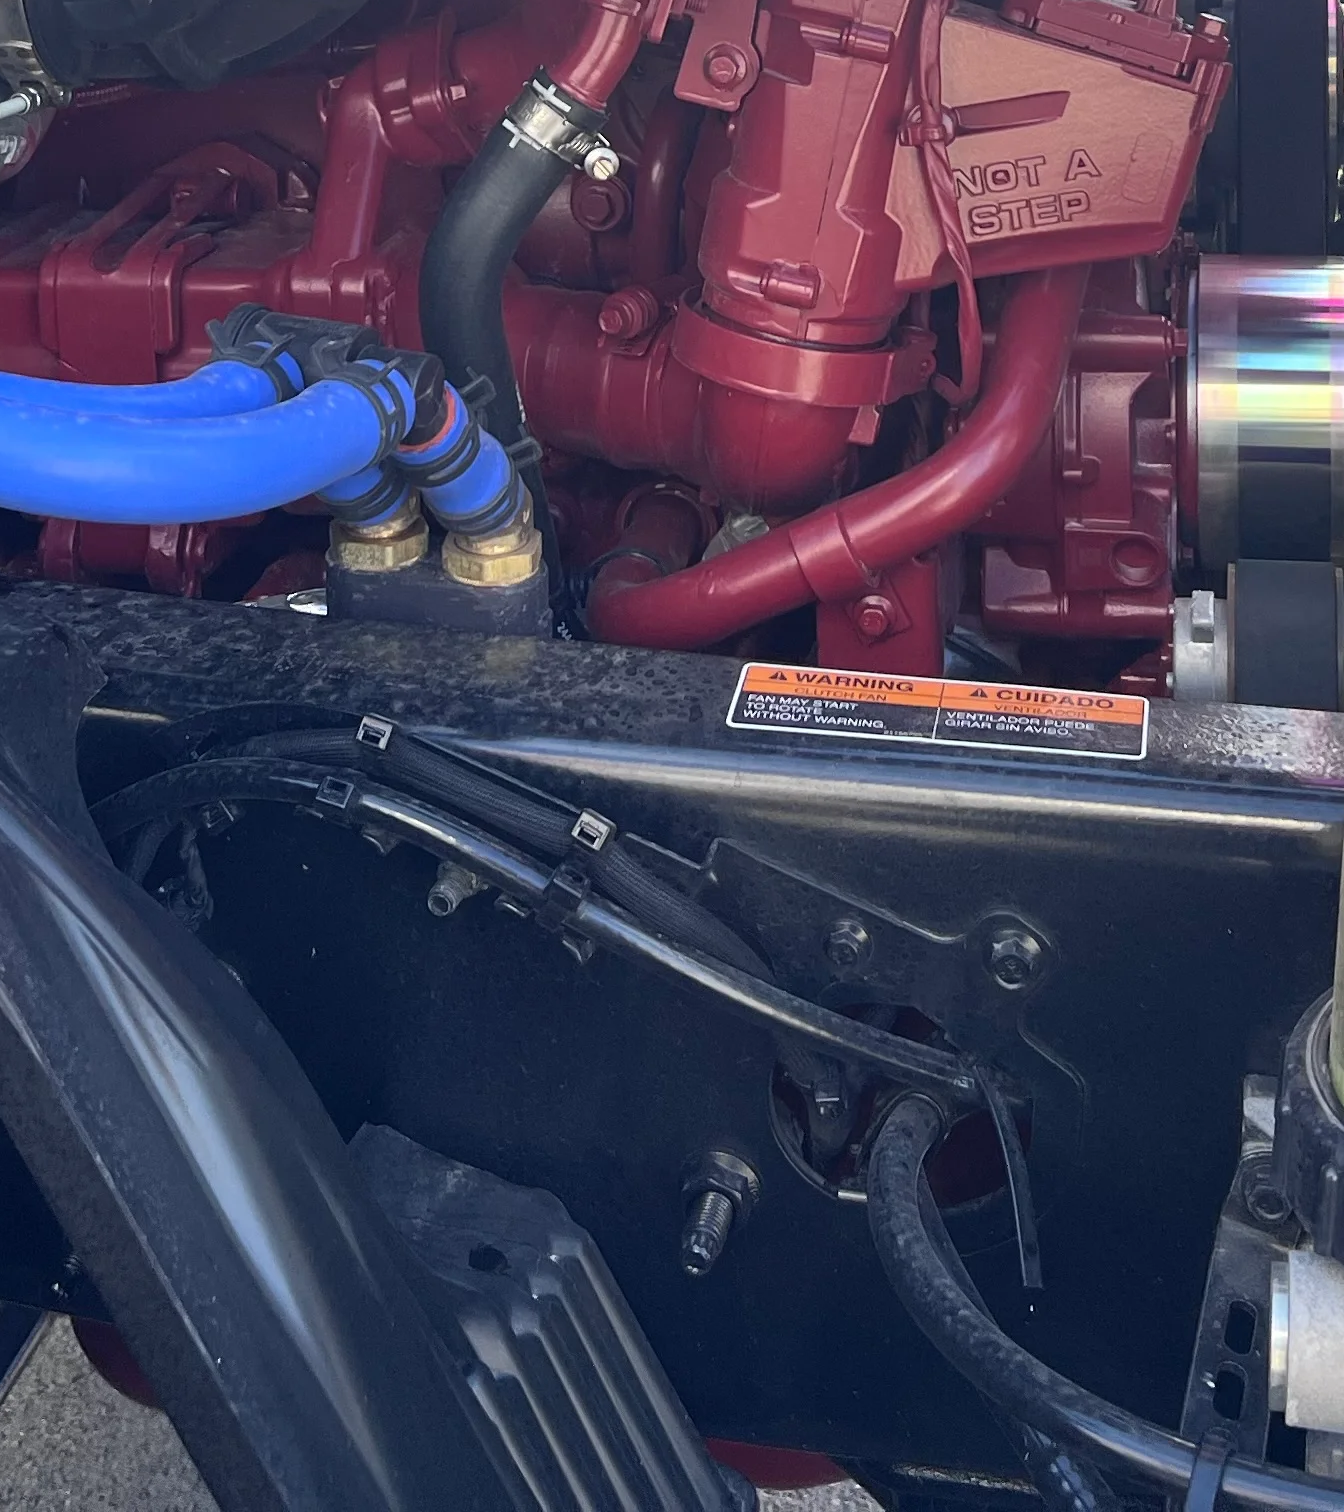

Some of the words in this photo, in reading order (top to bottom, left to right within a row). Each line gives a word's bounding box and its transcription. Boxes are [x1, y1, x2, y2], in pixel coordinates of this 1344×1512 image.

[954, 154, 1046, 199] NOT
[1064, 148, 1103, 181] A
[968, 189, 1091, 237] STEP
[795, 671, 914, 692] WARNING
[747, 693, 776, 703] FAN
[779, 697, 810, 707] MAY
[812, 699, 859, 711] START
[794, 687, 855, 700] CLUTCH
[857, 692, 887, 702] FAN
[996, 689, 1114, 709] CUIDADO
[746, 701, 766, 710] TO
[768, 703, 823, 716] ROTATE
[993, 703, 1087, 719] VENTILADOR
[743, 709, 809, 722] WITHOUT
[814, 715, 887, 729] WARNING.
[944, 718, 991, 730] GIRAR
[996, 723, 1021, 732] SIN
[946, 711, 1040, 726] VENTILADOR
[1044, 719, 1095, 731] PUEDE
